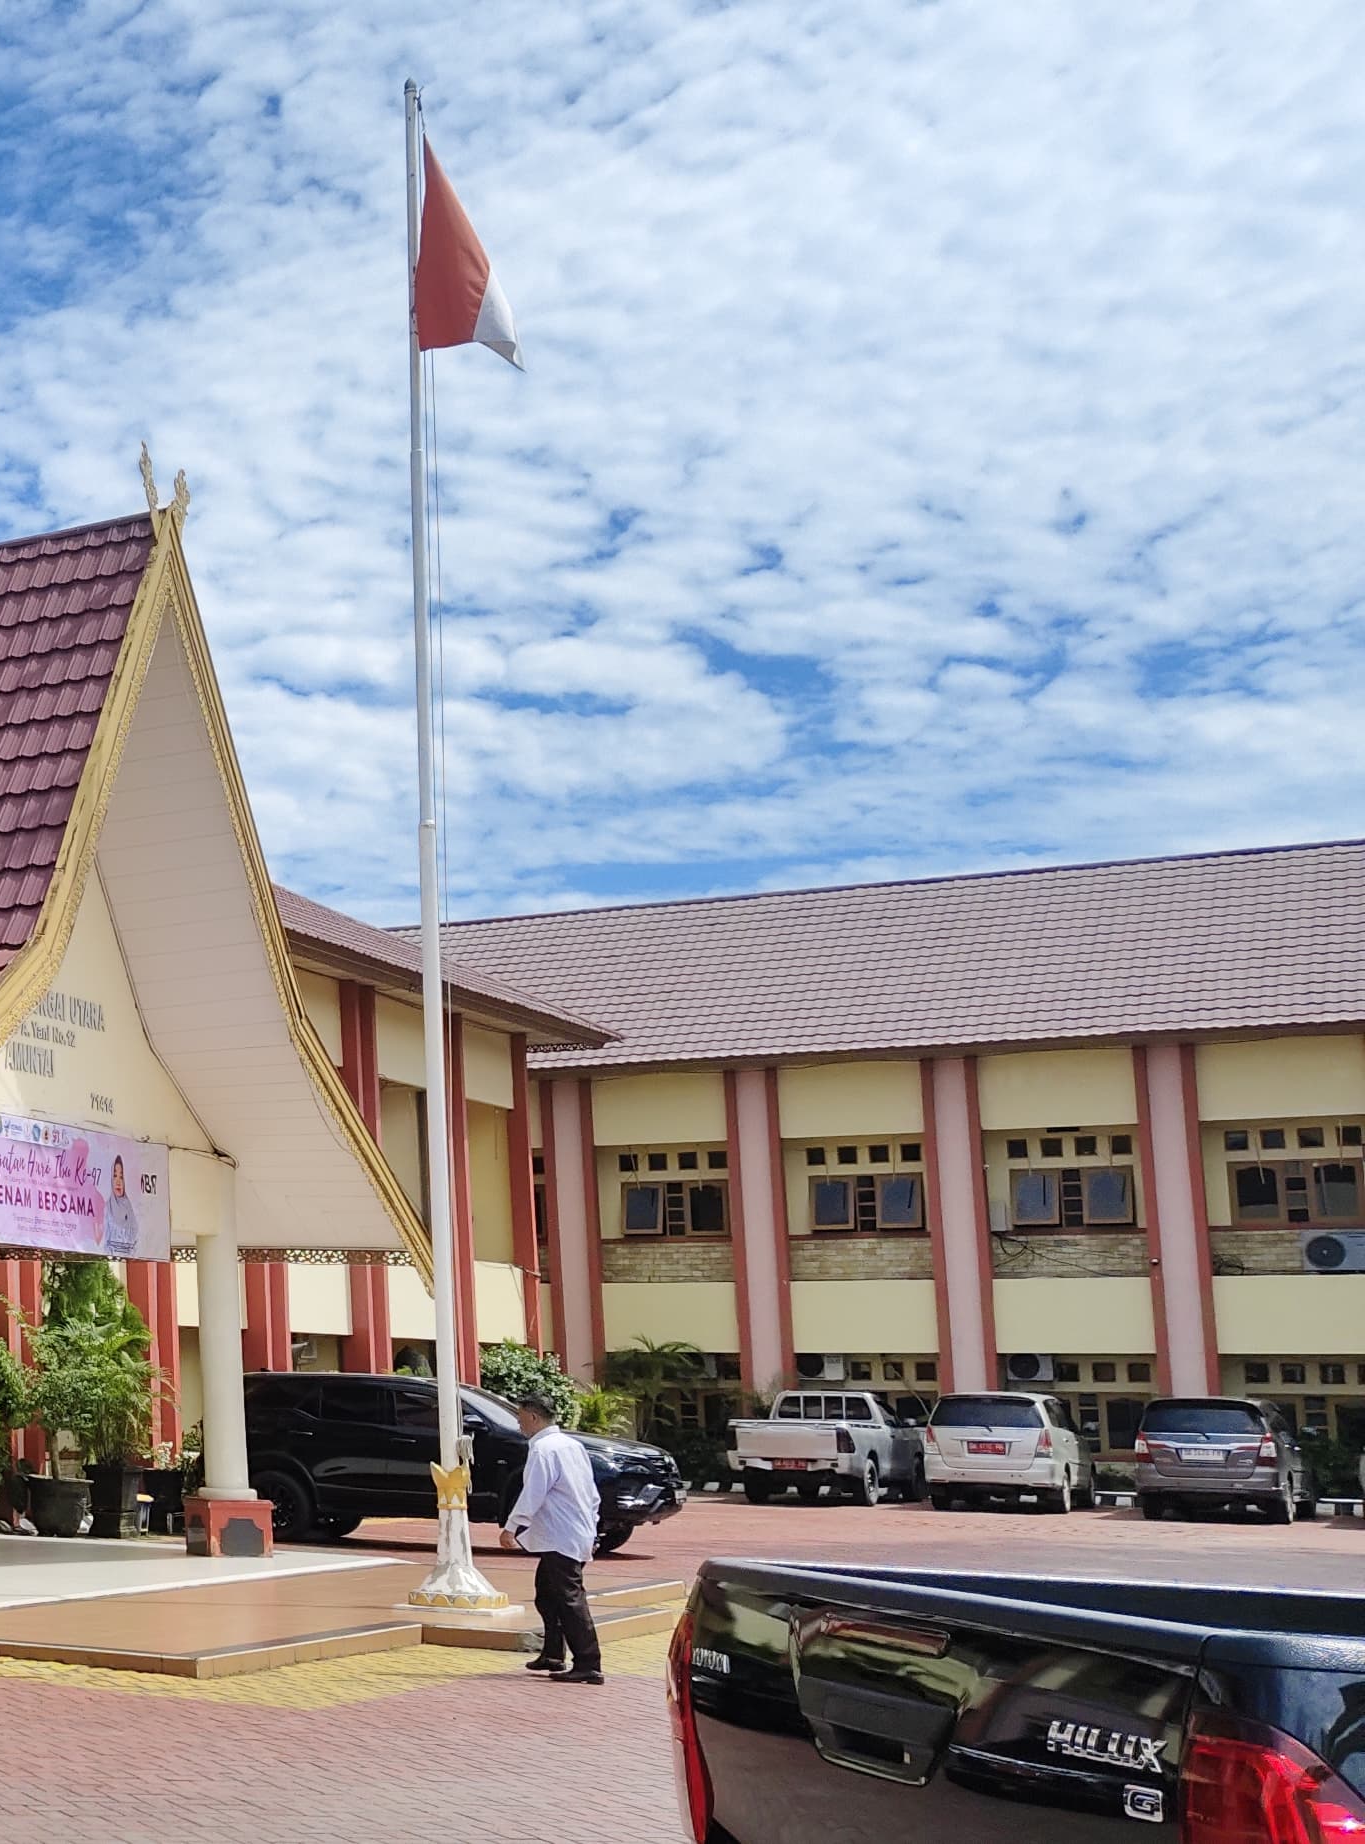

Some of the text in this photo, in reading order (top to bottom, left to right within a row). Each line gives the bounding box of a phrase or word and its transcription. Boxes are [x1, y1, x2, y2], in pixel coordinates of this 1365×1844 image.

[69, 995, 105, 1032] UTARA
[38, 1189, 95, 1218] BERSAMA
[1046, 1720, 1167, 1773] HILUX
